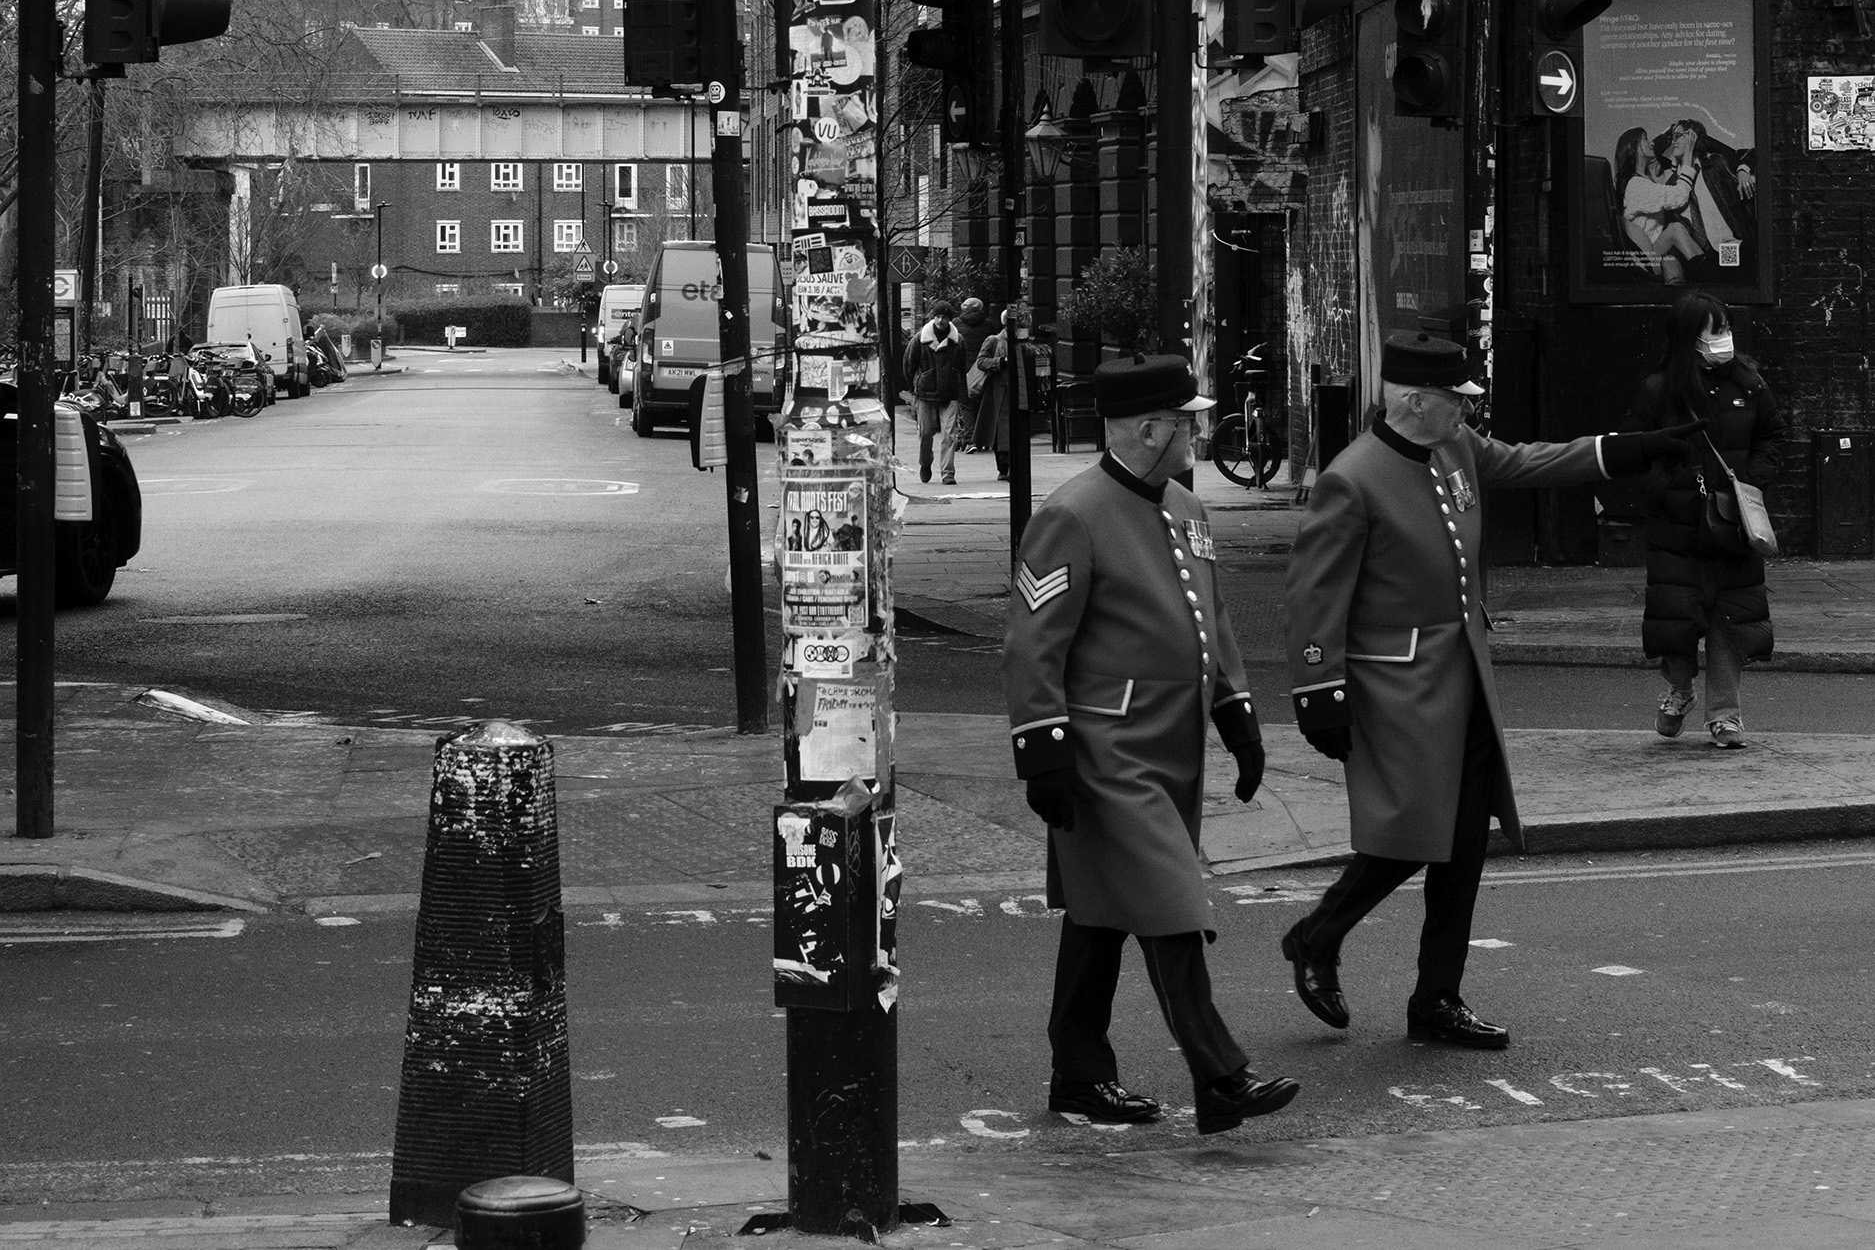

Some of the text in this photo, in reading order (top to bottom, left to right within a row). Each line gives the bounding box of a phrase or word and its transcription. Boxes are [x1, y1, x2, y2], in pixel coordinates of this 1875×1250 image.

[1664, 22, 1678, 31] only
[1661, 31, 1674, 39] Any
[1675, 30, 1695, 38] advice
[1636, 40, 1661, 48] another
[1662, 40, 1683, 49] gender
[1704, 38, 1717, 47] first
[1718, 37, 1735, 45] time?
[818, 122, 837, 139] VU
[808, 204, 845, 217] BASSROOM
[816, 273, 844, 284] SAUVE
[791, 435, 826, 444] supersonic
[801, 491, 827, 512] ROOTS
[828, 491, 848, 512] FEST
[820, 826, 839, 844] BASS
[786, 856, 817, 868] BDK
